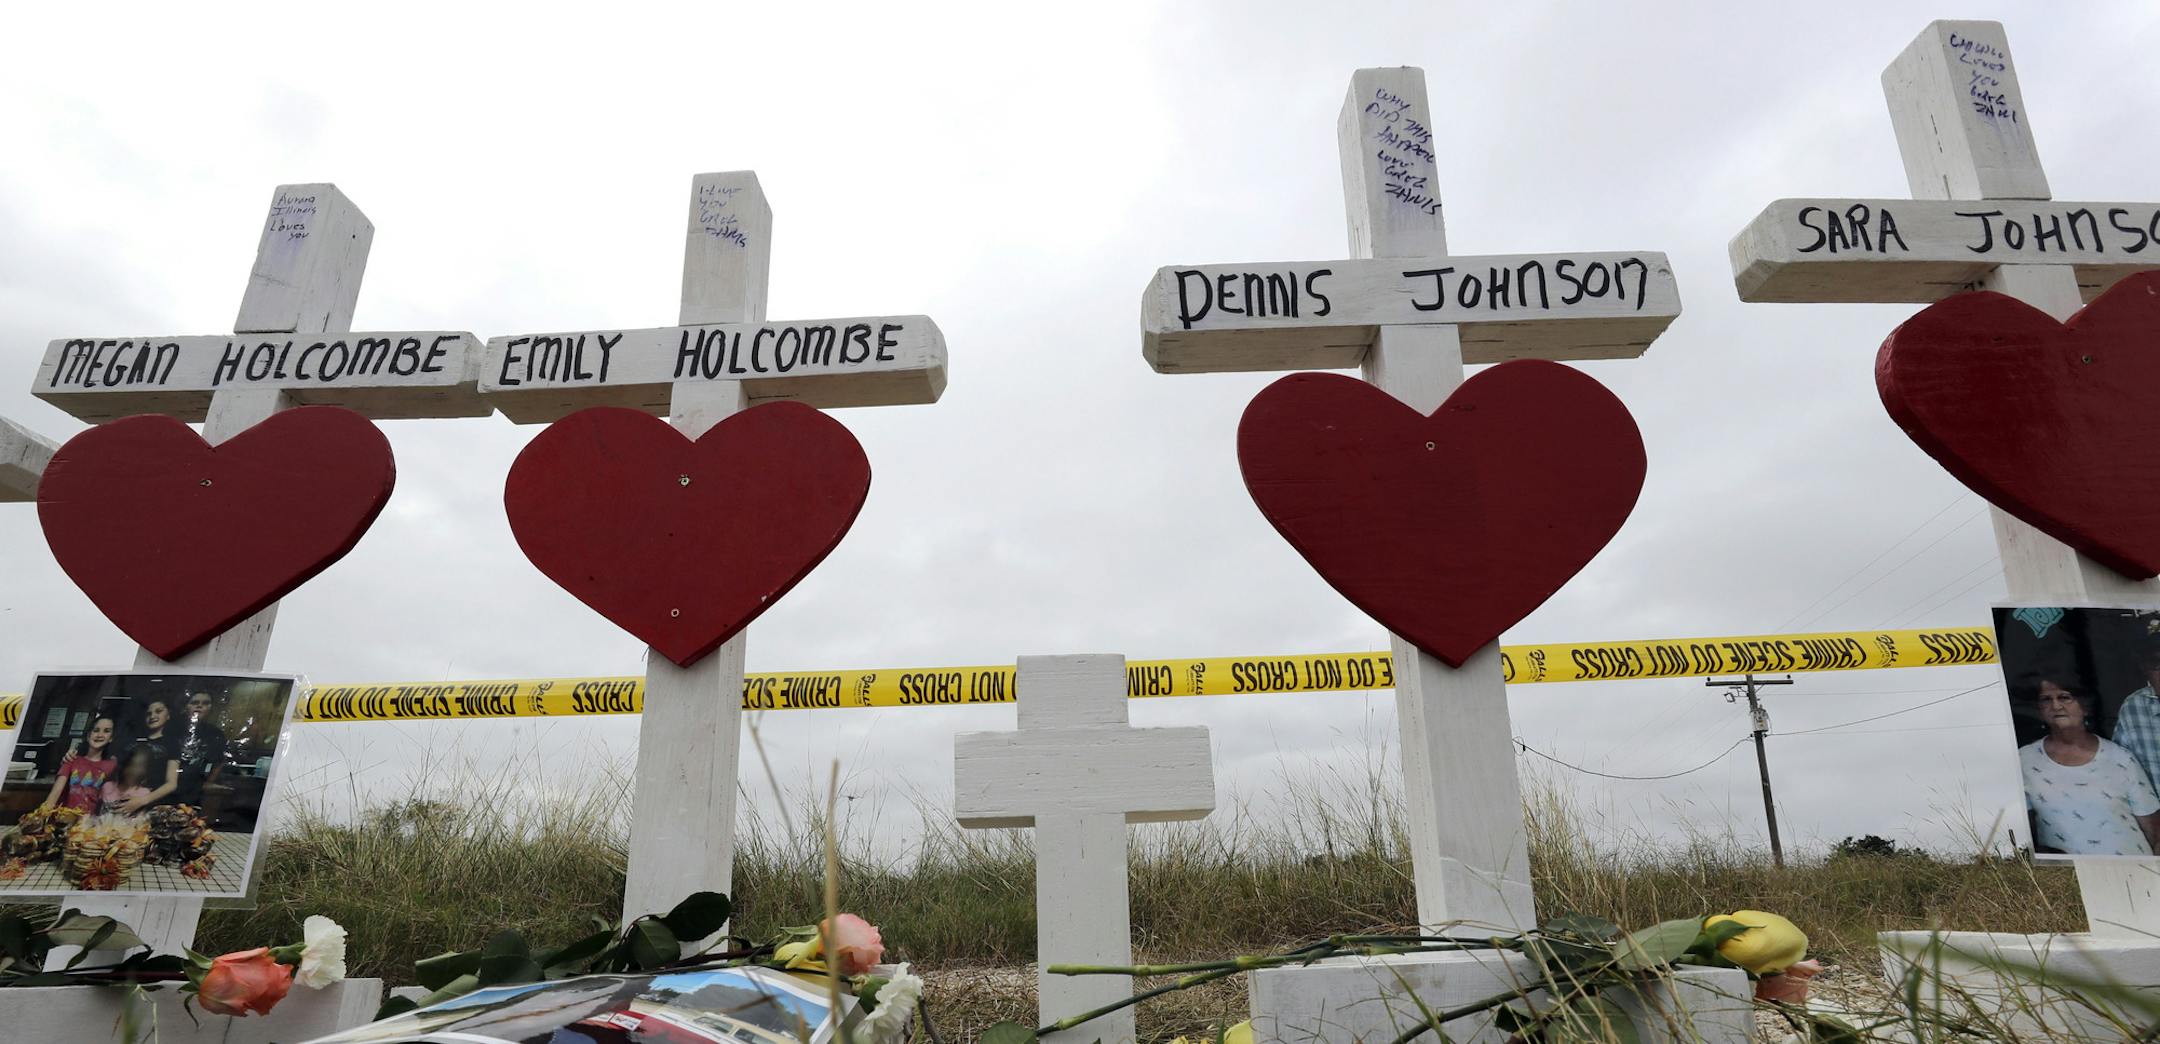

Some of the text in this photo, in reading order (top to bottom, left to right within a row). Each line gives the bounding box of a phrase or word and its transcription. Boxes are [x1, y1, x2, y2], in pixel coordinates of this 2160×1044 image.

[1365, 101, 1401, 123] DID
[1796, 203, 1910, 254] SARA
[1174, 257, 1649, 329] DENNIS JOHNSON
[50, 335, 462, 388] MEGAN HOLCOMBE
[499, 323, 904, 386] EMILY HOLCOMBE
[1571, 646, 1644, 680] CROSS
[1646, 644, 1690, 676] NOT
[1690, 643, 1724, 674] DO
[1722, 640, 1796, 673] SCENE
[1792, 637, 1868, 670] CRIME
[1918, 631, 1994, 665] CROSS
[899, 671, 962, 704] CROSS
[968, 671, 1005, 702] NOT
[1126, 665, 1173, 697] CRIM
[1231, 660, 1299, 693] CROSS
[1303, 658, 1343, 690] NOT
[1347, 657, 1376, 688] DO
[319, 688, 361, 719] NOT
[358, 686, 393, 718] DO
[389, 685, 455, 717] SCENE
[455, 683, 519, 716] CRIME
[572, 680, 638, 713] CROSS
[742, 677, 777, 708] SCE
[780, 675, 842, 708] CRIME
